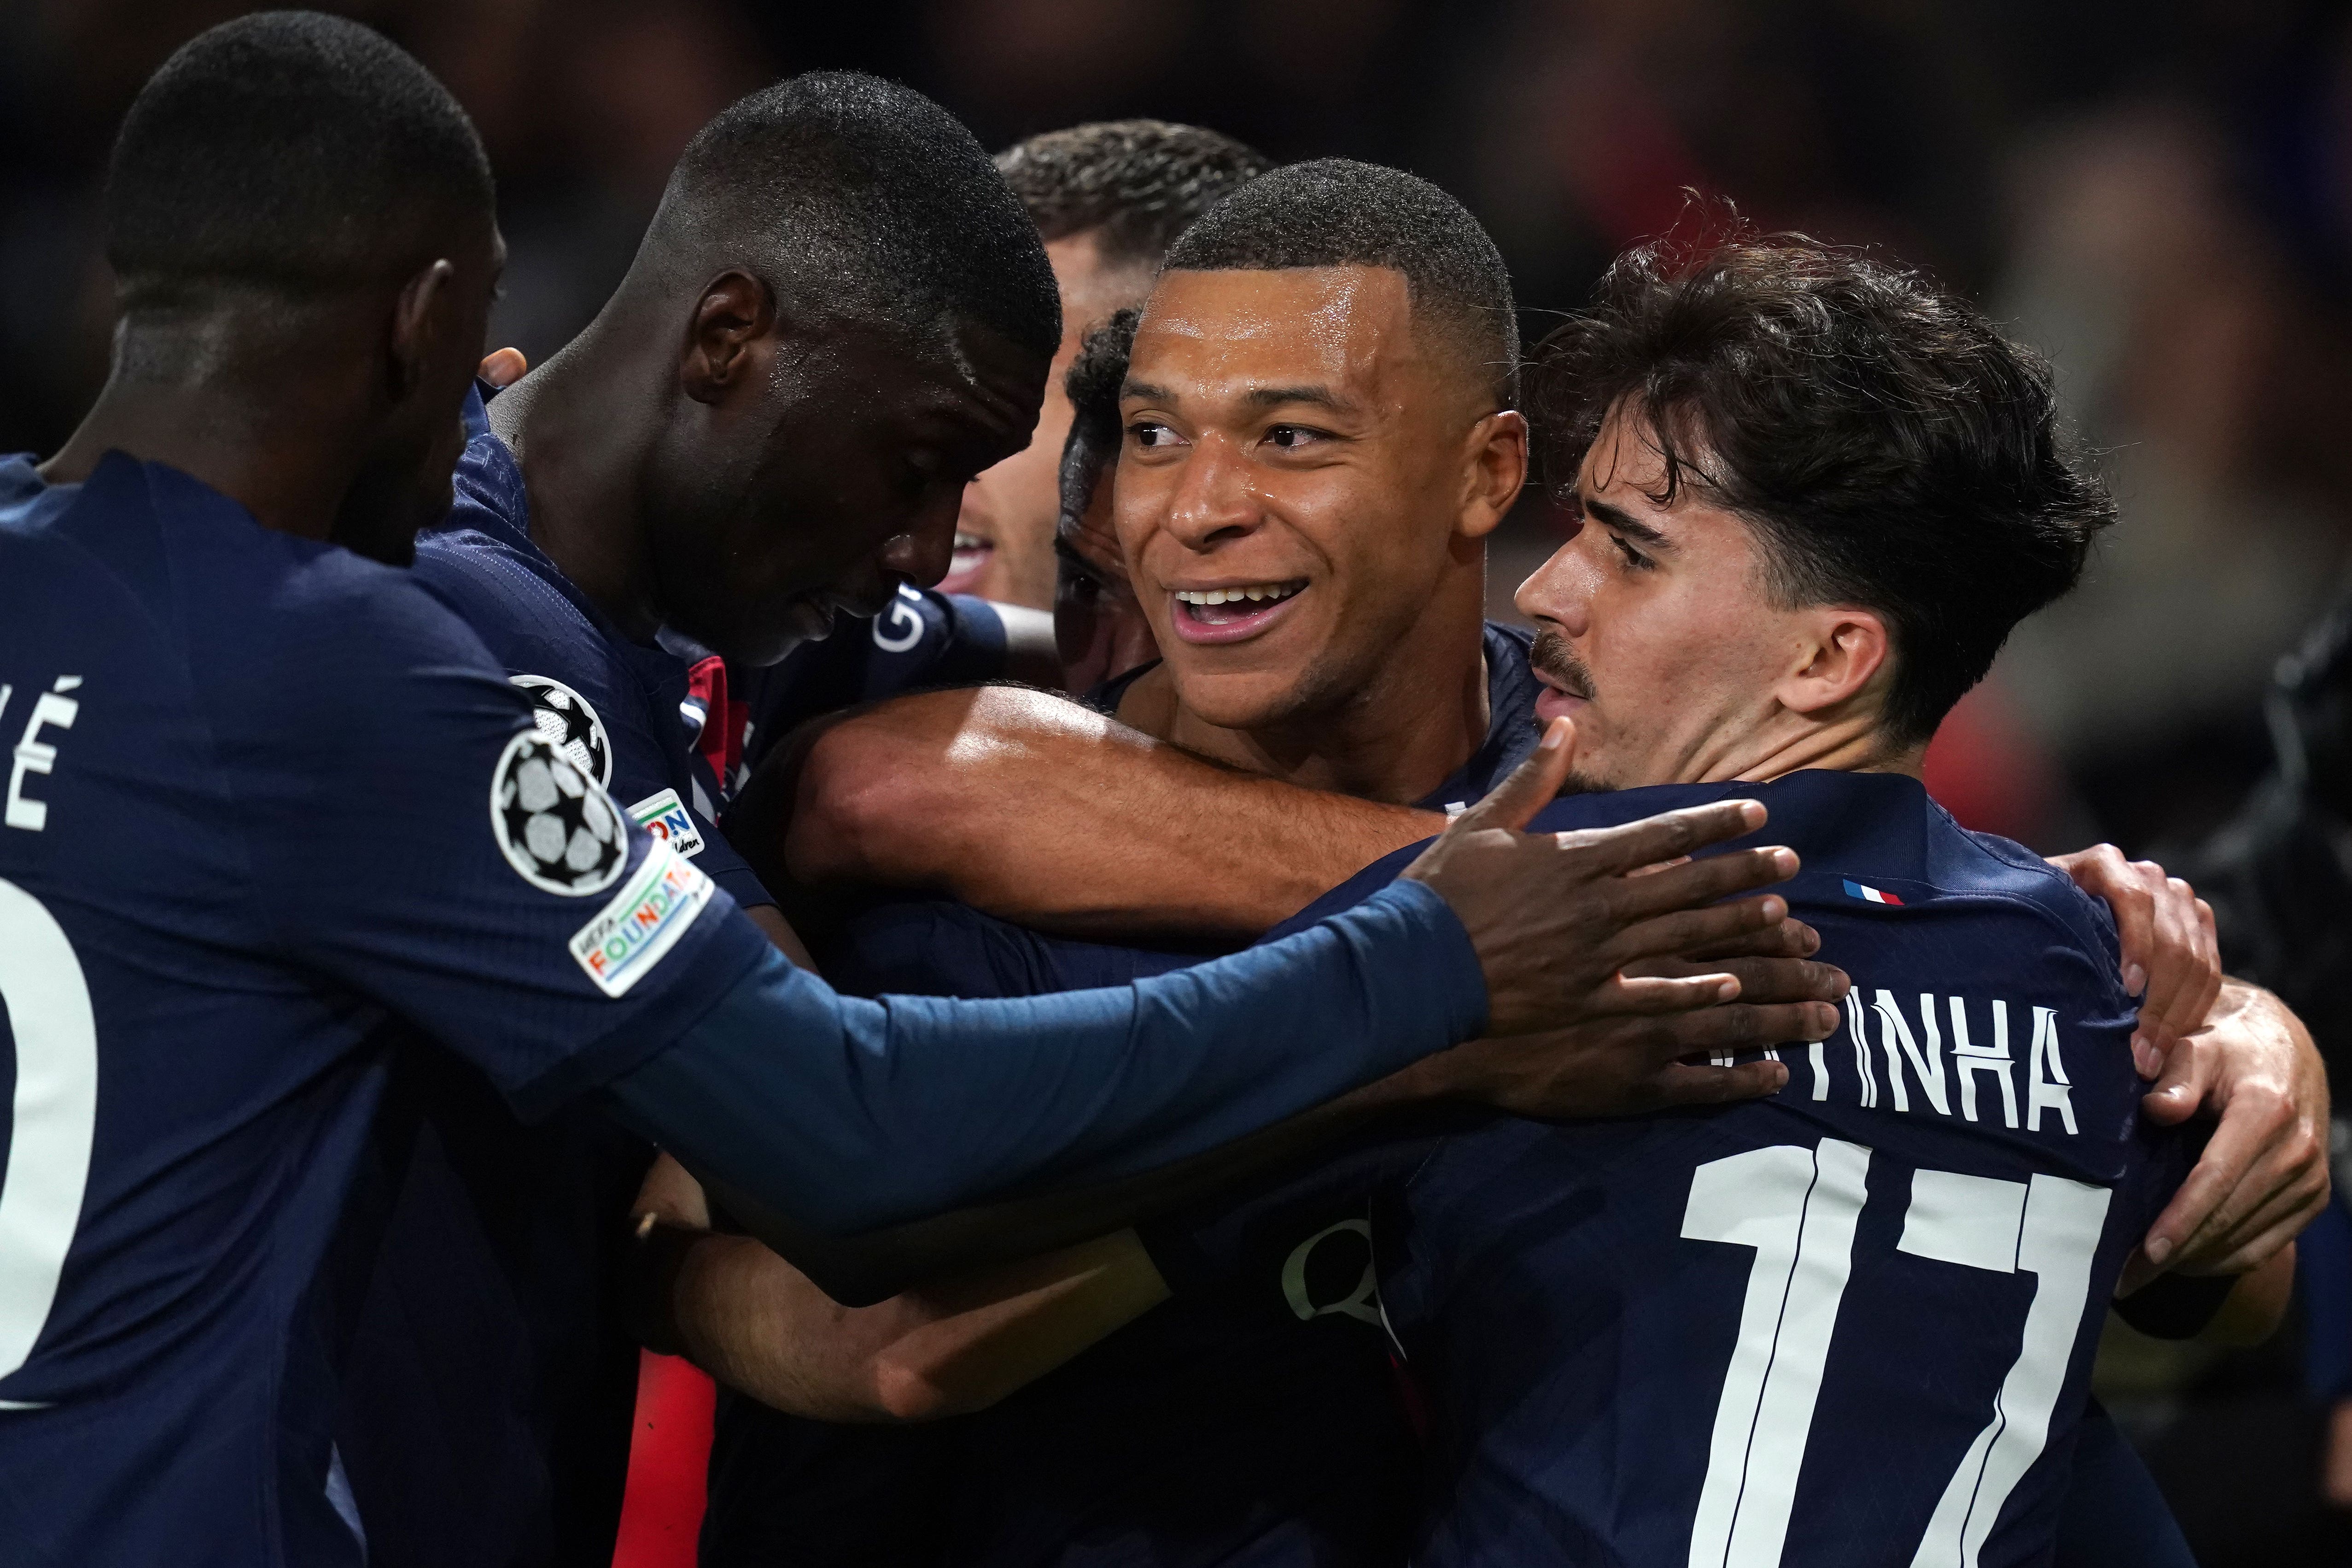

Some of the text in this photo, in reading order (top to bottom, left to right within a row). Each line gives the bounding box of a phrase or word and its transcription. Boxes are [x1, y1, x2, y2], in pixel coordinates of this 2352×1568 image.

[872, 583, 925, 653] G
[0, 674, 84, 832] É
[1680, 1137, 2113, 1568] 17
